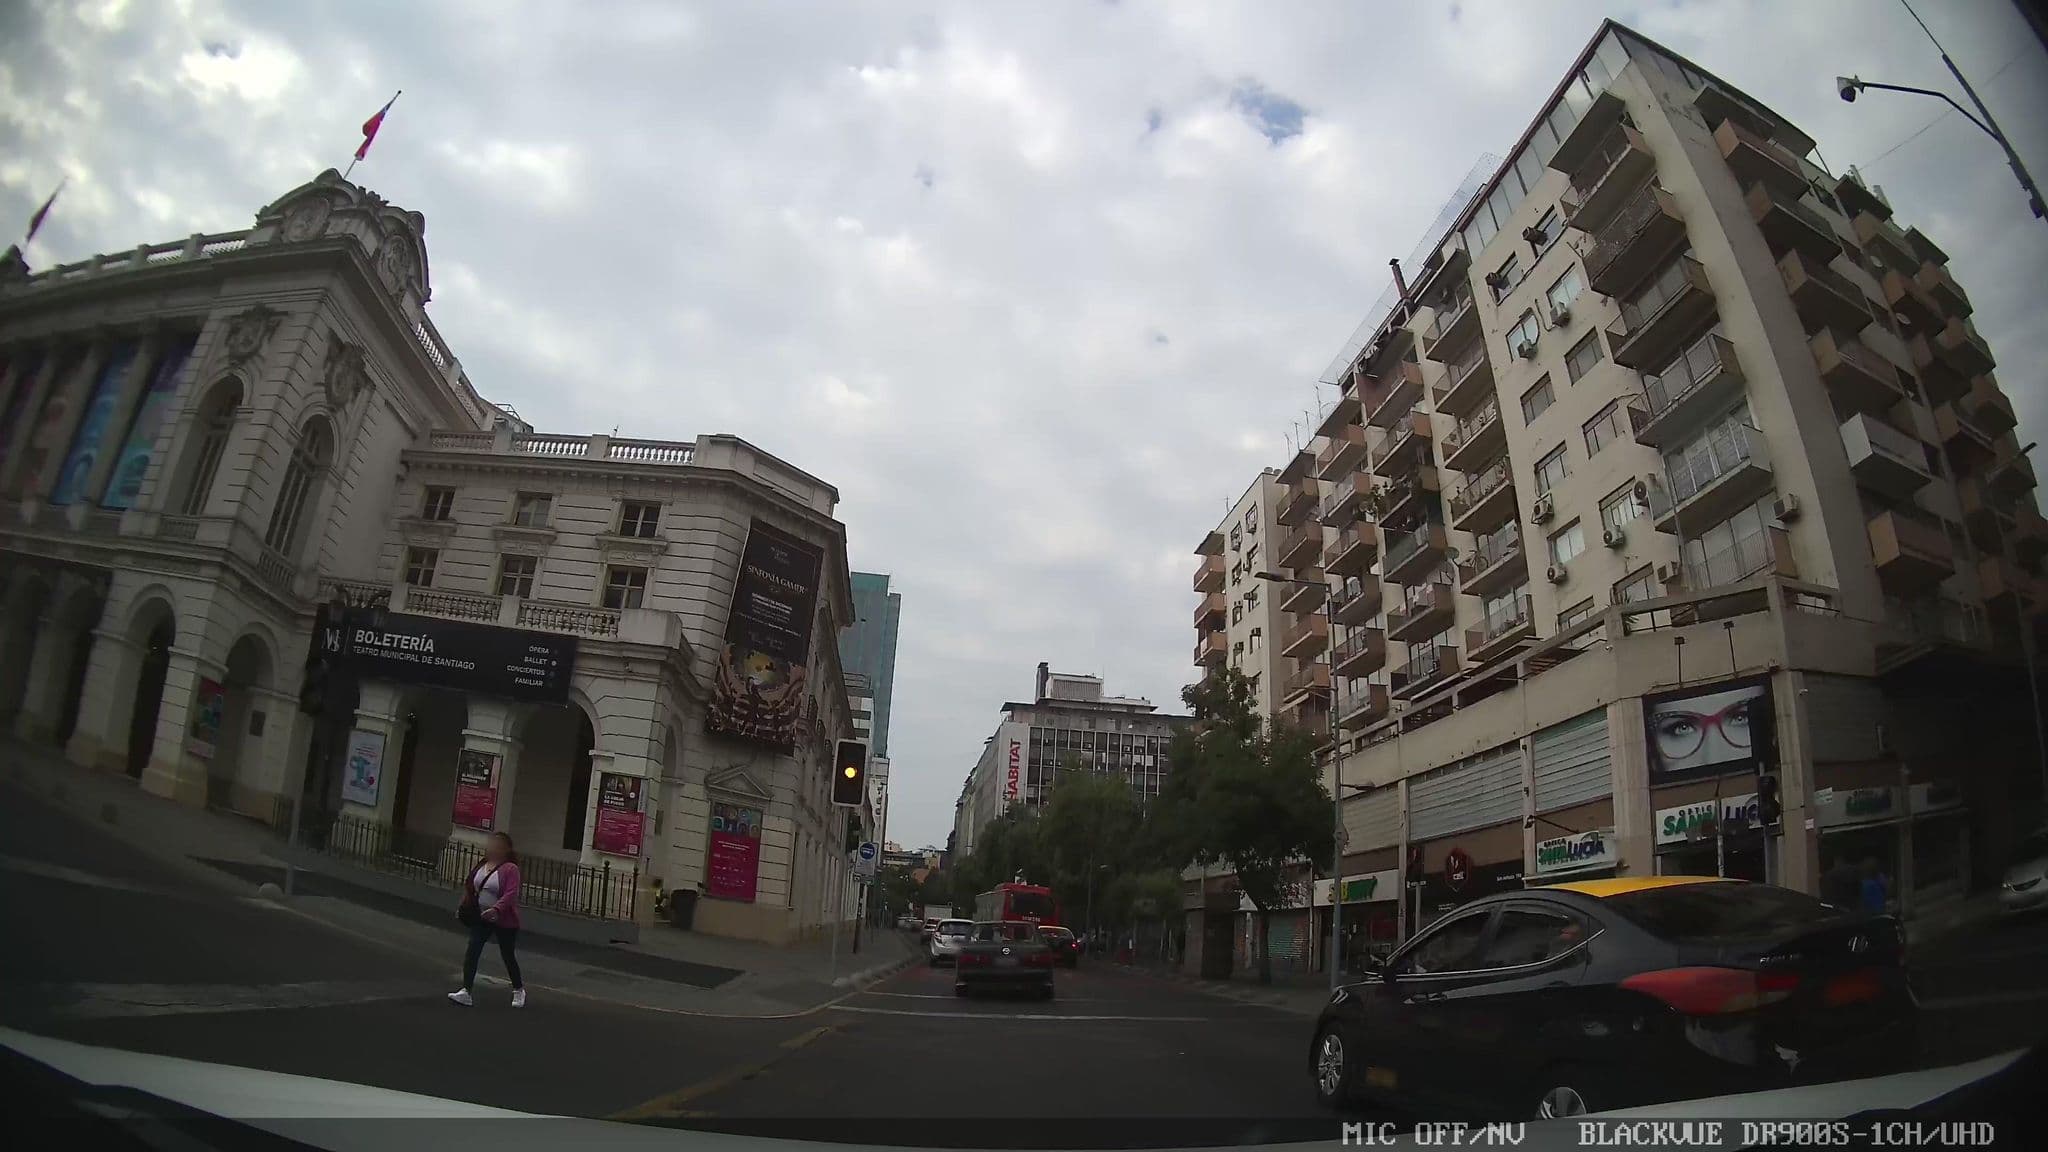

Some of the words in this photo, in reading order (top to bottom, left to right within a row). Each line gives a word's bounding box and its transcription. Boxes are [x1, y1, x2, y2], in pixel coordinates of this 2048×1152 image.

[354, 629, 434, 653] BOLETERÍA
[353, 645, 379, 657] TEATRO
[380, 649, 420, 663] MUNICIPAL
[421, 655, 433, 665] DE
[434, 657, 476, 671] SANTIAGO
[524, 656, 548, 665] BALLET
[506, 664, 545, 676] CONCIERTOS
[514, 677, 544, 687] FAMILIAR
[1007, 738, 1021, 801] HABITAT
